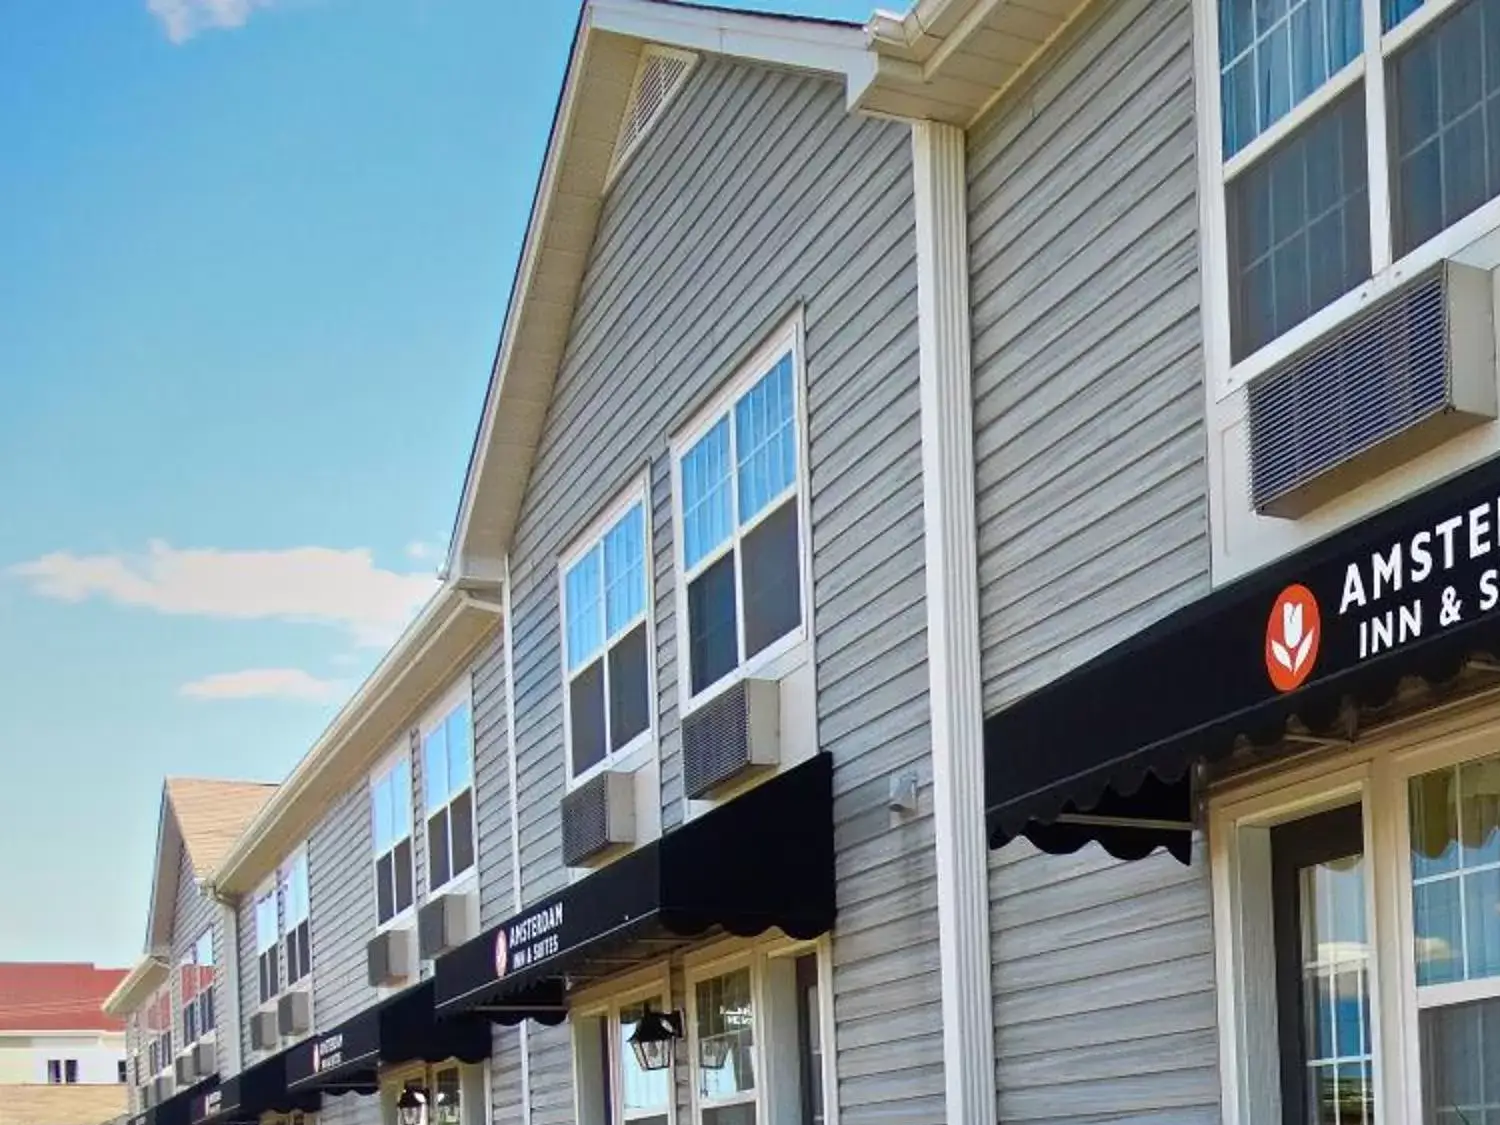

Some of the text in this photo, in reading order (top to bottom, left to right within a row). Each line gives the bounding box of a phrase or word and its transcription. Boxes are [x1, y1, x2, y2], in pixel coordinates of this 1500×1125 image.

[1359, 600, 1422, 658] INN
[1439, 585, 1462, 626] &
[509, 901, 563, 948] AMSTERDAM
